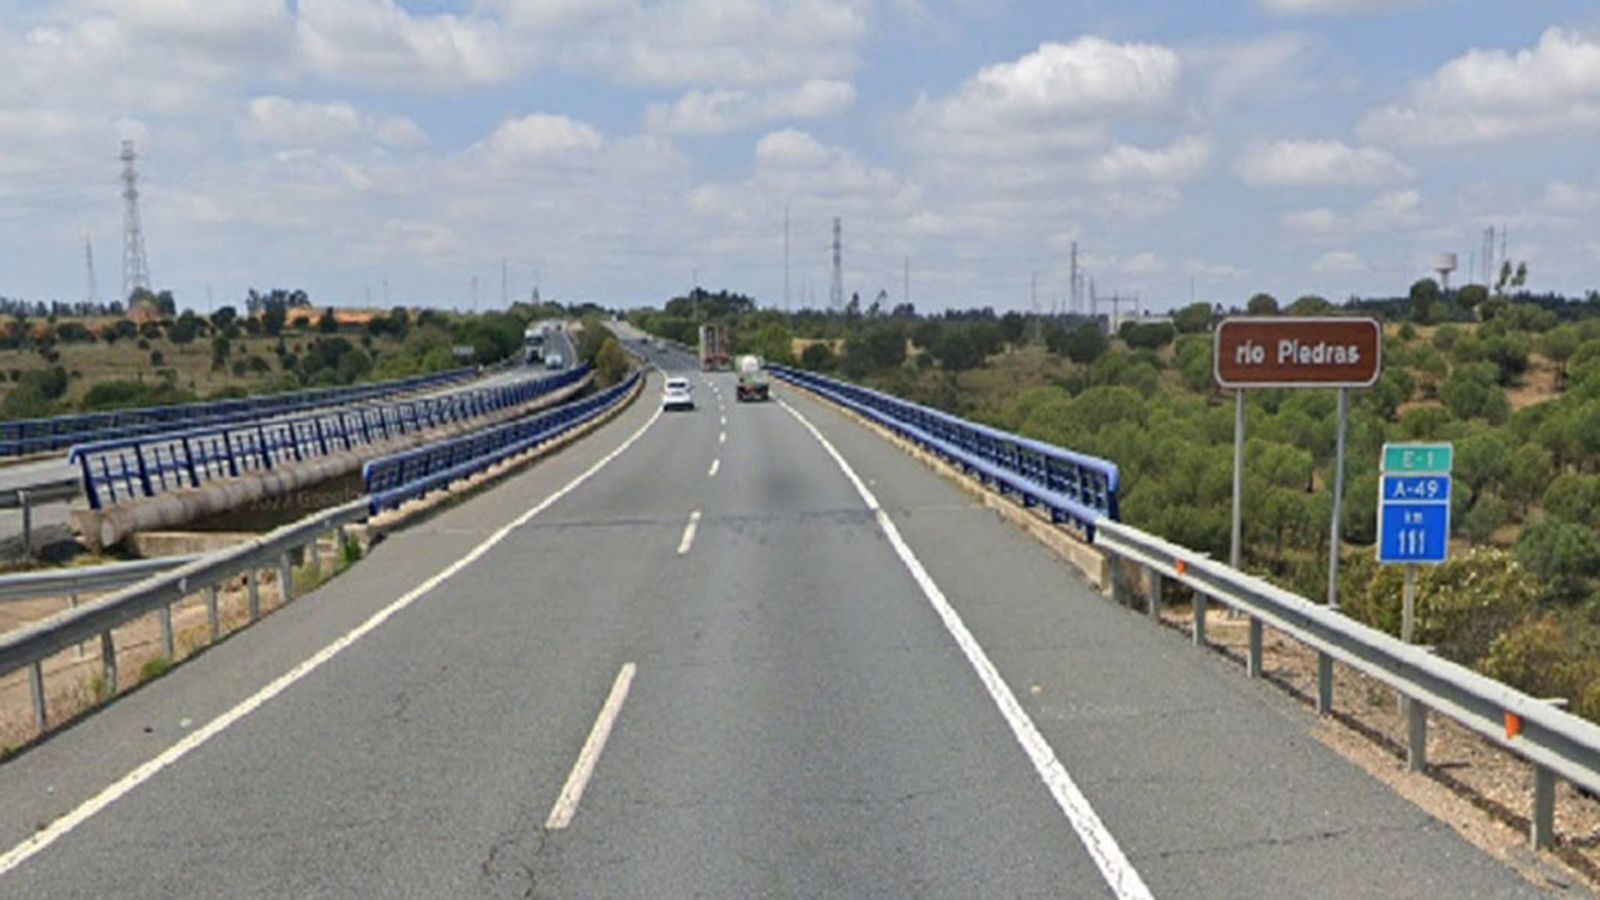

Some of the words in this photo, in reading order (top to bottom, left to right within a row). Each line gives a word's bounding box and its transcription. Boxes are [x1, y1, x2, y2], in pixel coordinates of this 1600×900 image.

[1278, 338, 1360, 364] Piedras
[1403, 451, 1434, 469] E-1
[1393, 480, 1439, 497] A-49
[1399, 529, 1425, 555] 111
